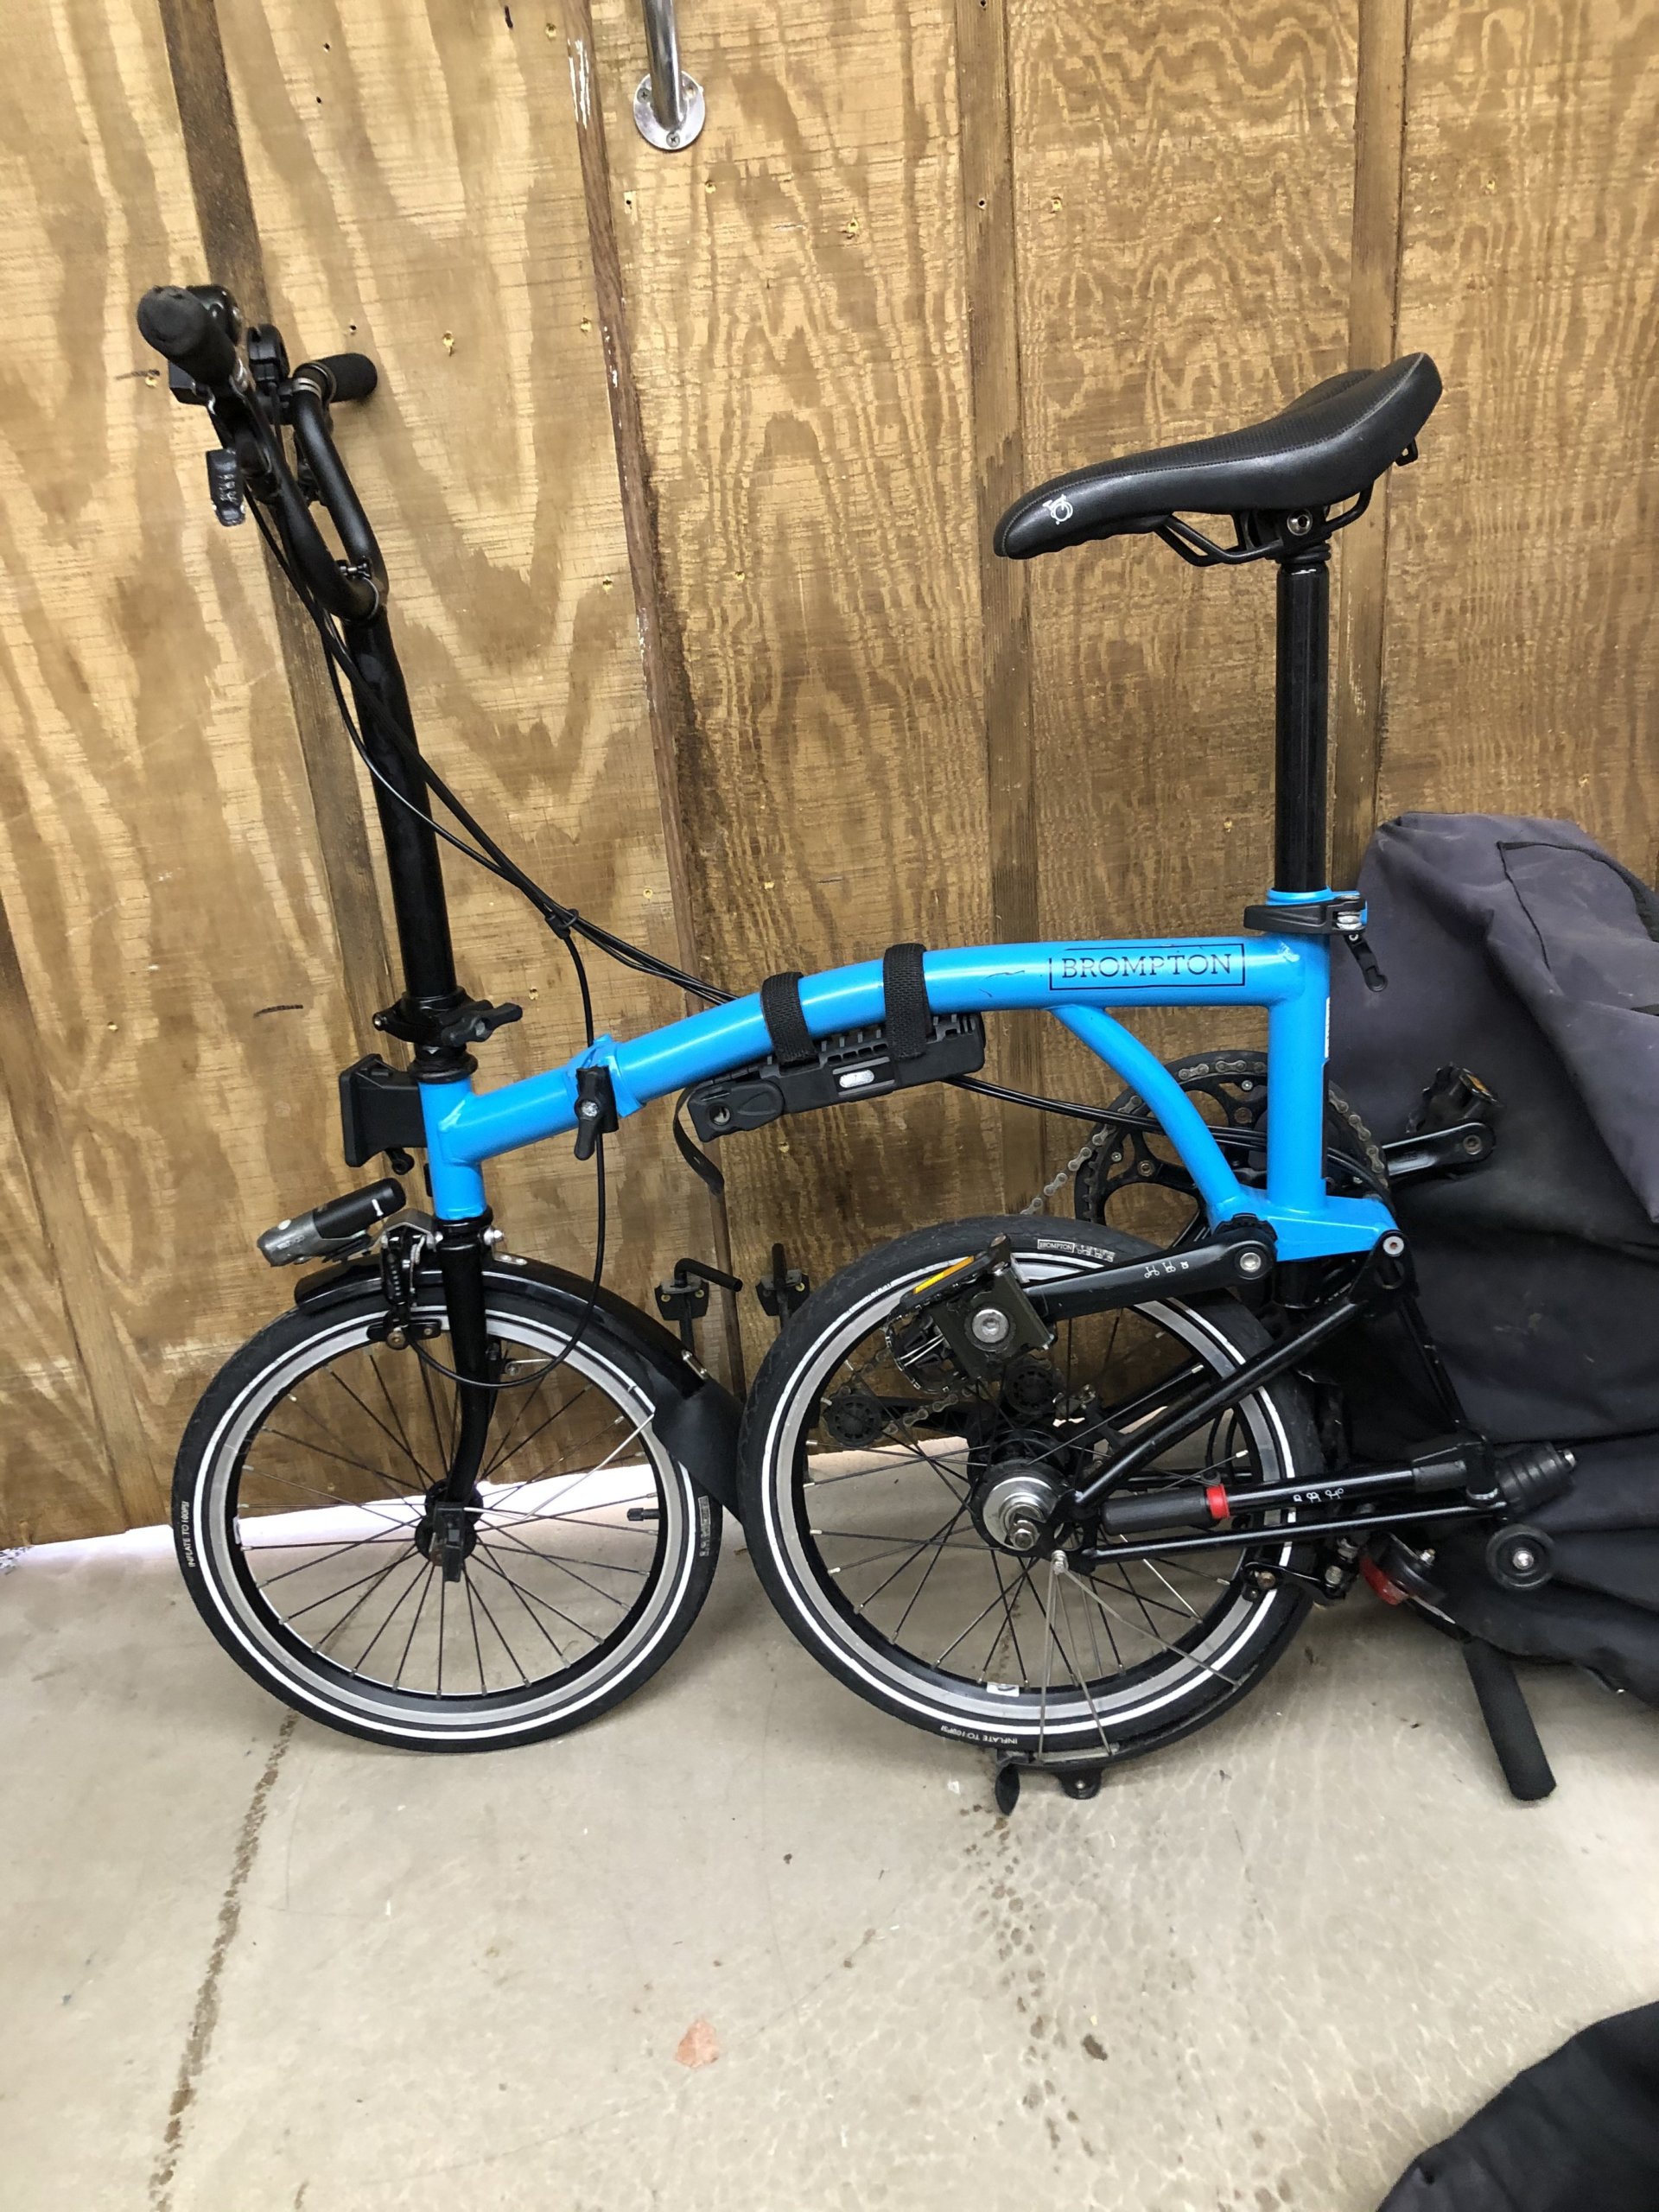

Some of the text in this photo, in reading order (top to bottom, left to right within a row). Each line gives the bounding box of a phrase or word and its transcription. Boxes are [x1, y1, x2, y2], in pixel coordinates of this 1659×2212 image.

[1061, 953, 1231, 978] BROMPTON
[181, 1524, 189, 1535] TO
[181, 1537, 196, 1567] INFLATE
[982, 1735, 1018, 1745] INFLATE
